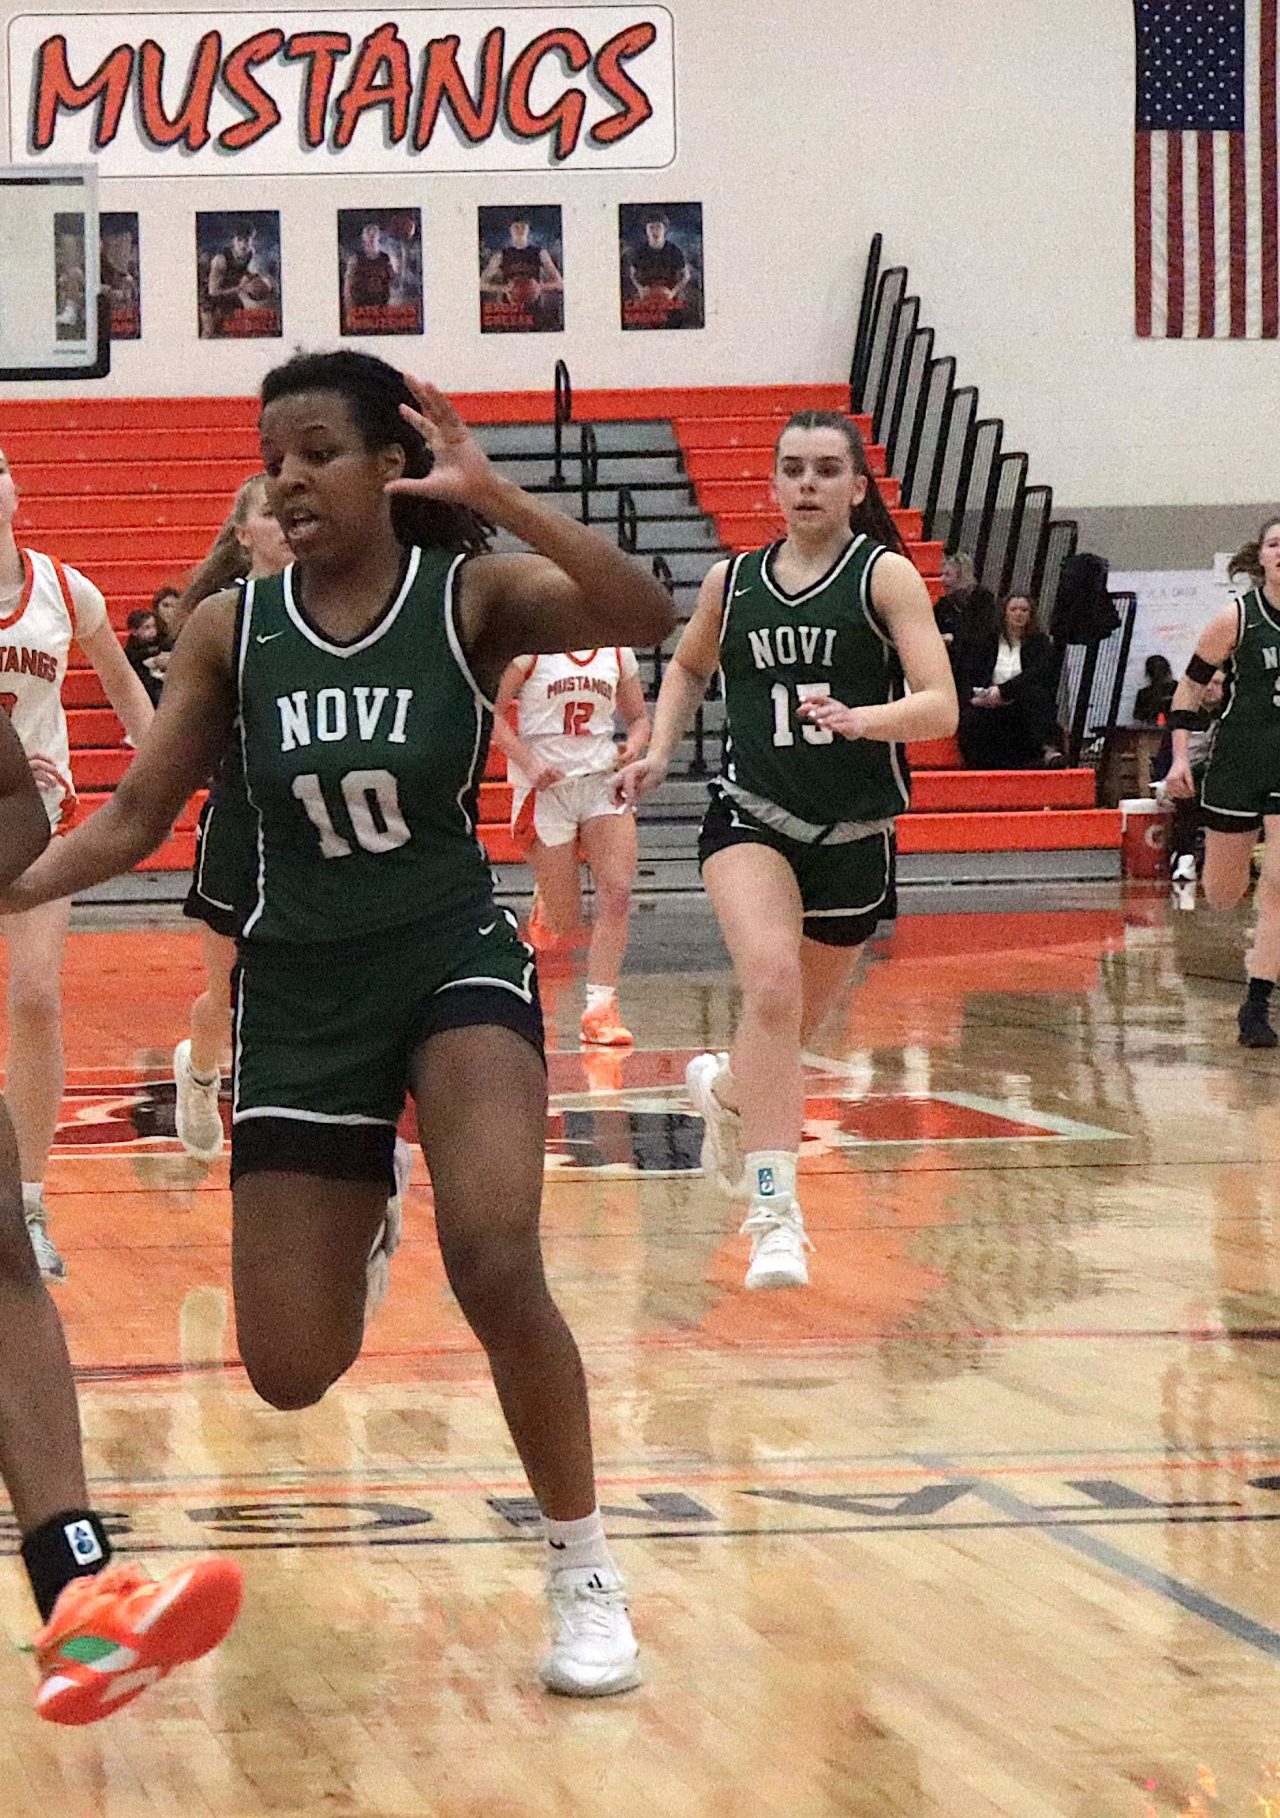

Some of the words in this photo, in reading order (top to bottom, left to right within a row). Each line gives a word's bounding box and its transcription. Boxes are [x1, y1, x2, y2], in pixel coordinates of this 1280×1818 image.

[26, 22, 658, 161] MUSTANGS
[747, 625, 837, 670] NOVI
[276, 686, 414, 752] NOVI
[562, 701, 595, 736] 12
[291, 769, 412, 859] 10
